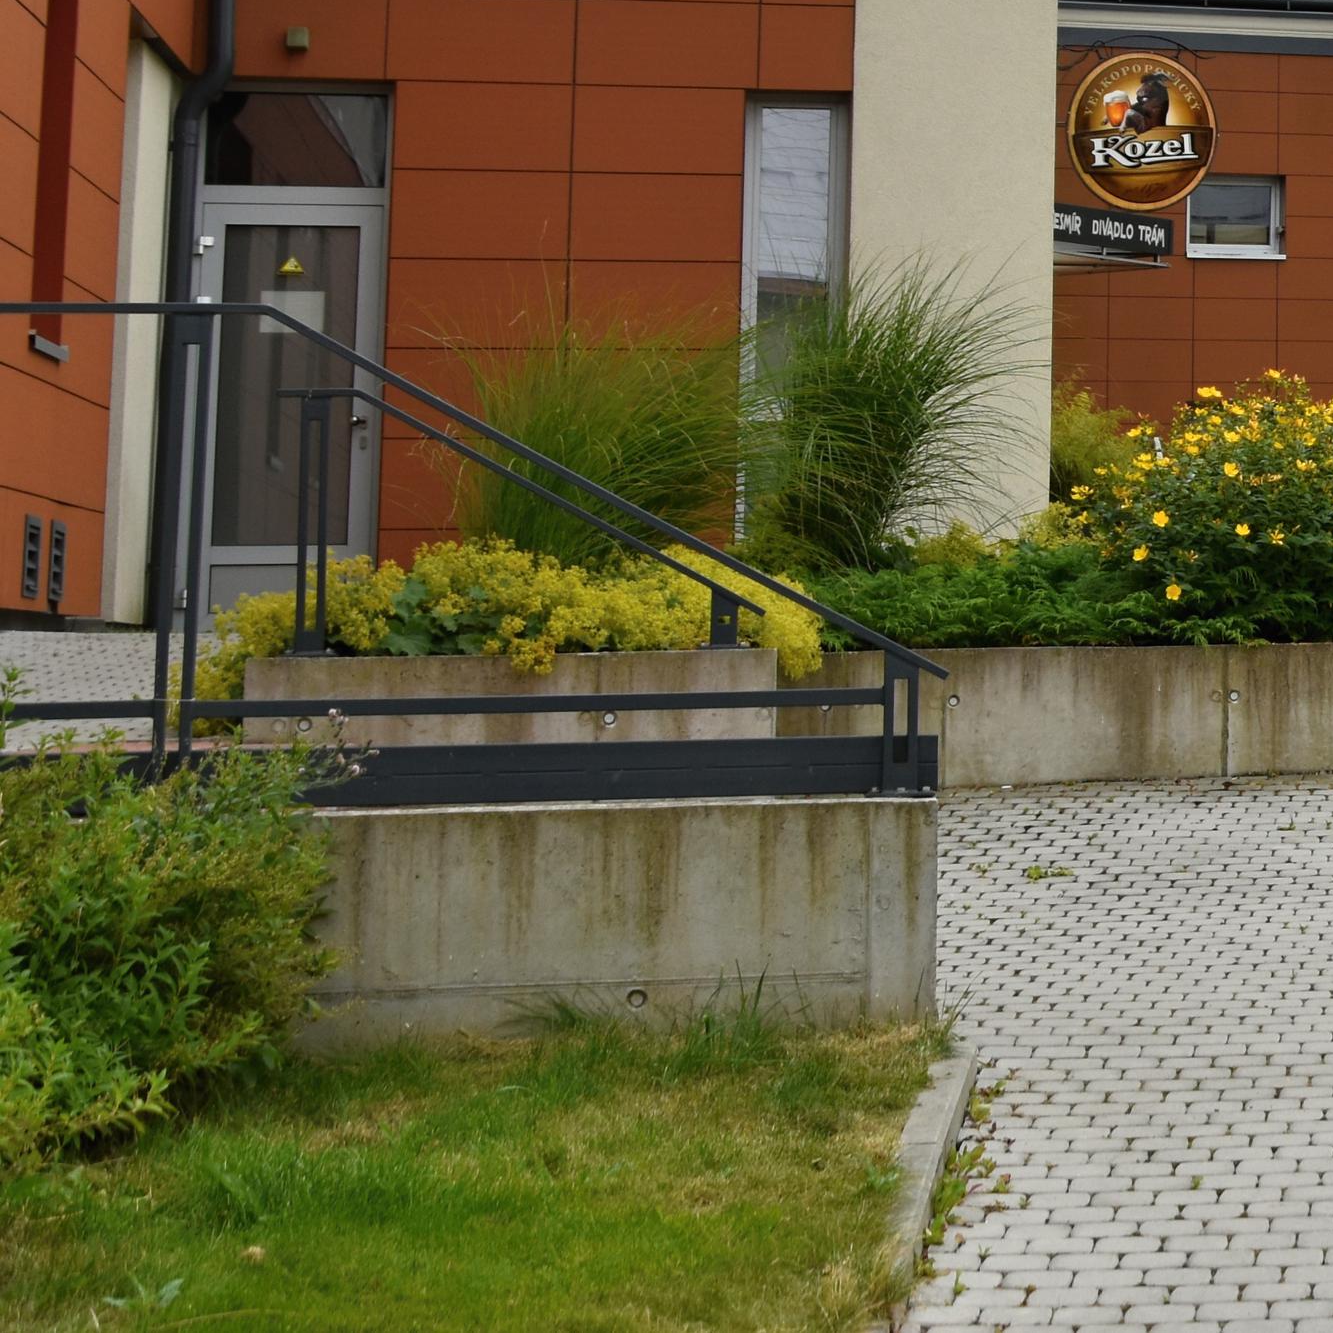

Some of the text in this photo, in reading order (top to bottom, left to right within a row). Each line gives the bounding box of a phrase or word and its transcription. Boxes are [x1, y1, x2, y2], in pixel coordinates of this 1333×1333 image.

[1090, 133, 1197, 167] Kozel
[1053, 212, 1165, 247] ESMÍR DIVADLO TRÁM
